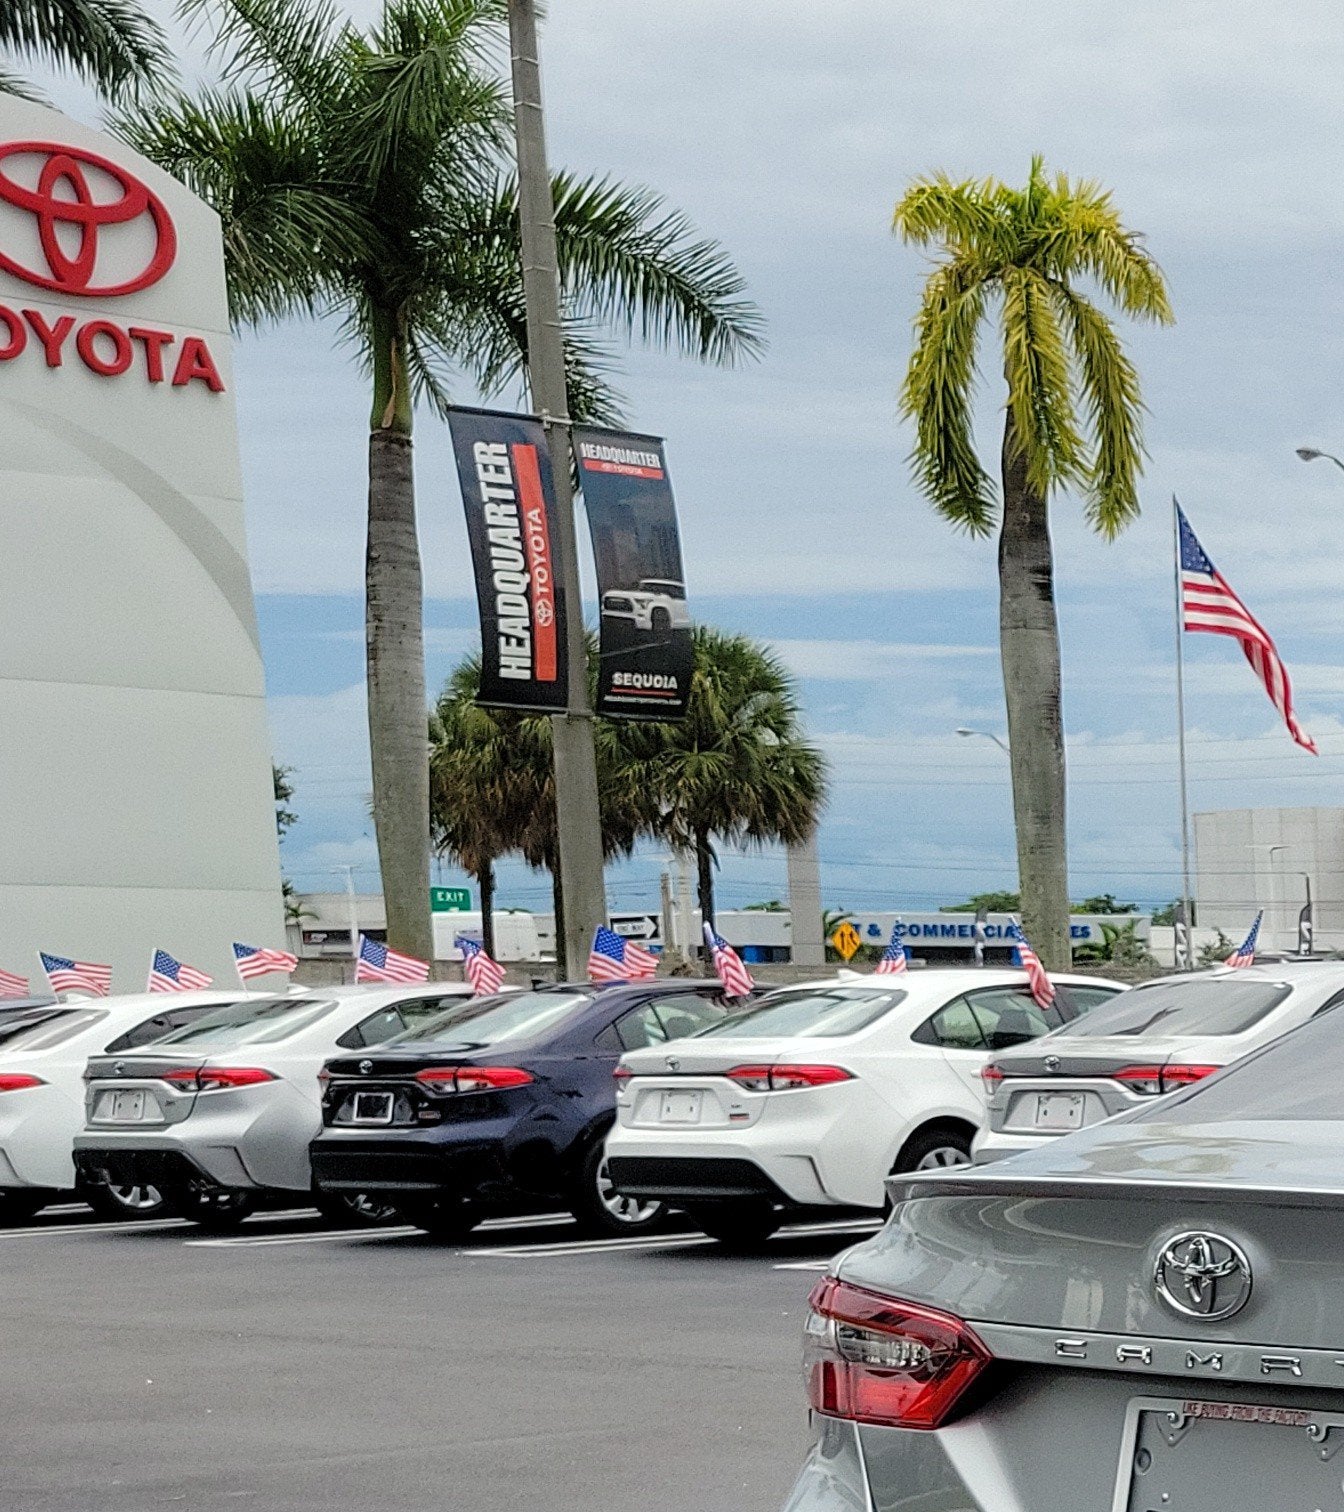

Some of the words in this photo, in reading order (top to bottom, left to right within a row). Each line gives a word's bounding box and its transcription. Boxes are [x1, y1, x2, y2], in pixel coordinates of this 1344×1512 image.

[580, 442, 661, 468] HEADQUARTER
[473, 440, 531, 681] HEADQUARTER
[526, 507, 550, 595] TOYOTA
[612, 671, 678, 689] SEQUOIA
[436, 890, 464, 902] EXIT
